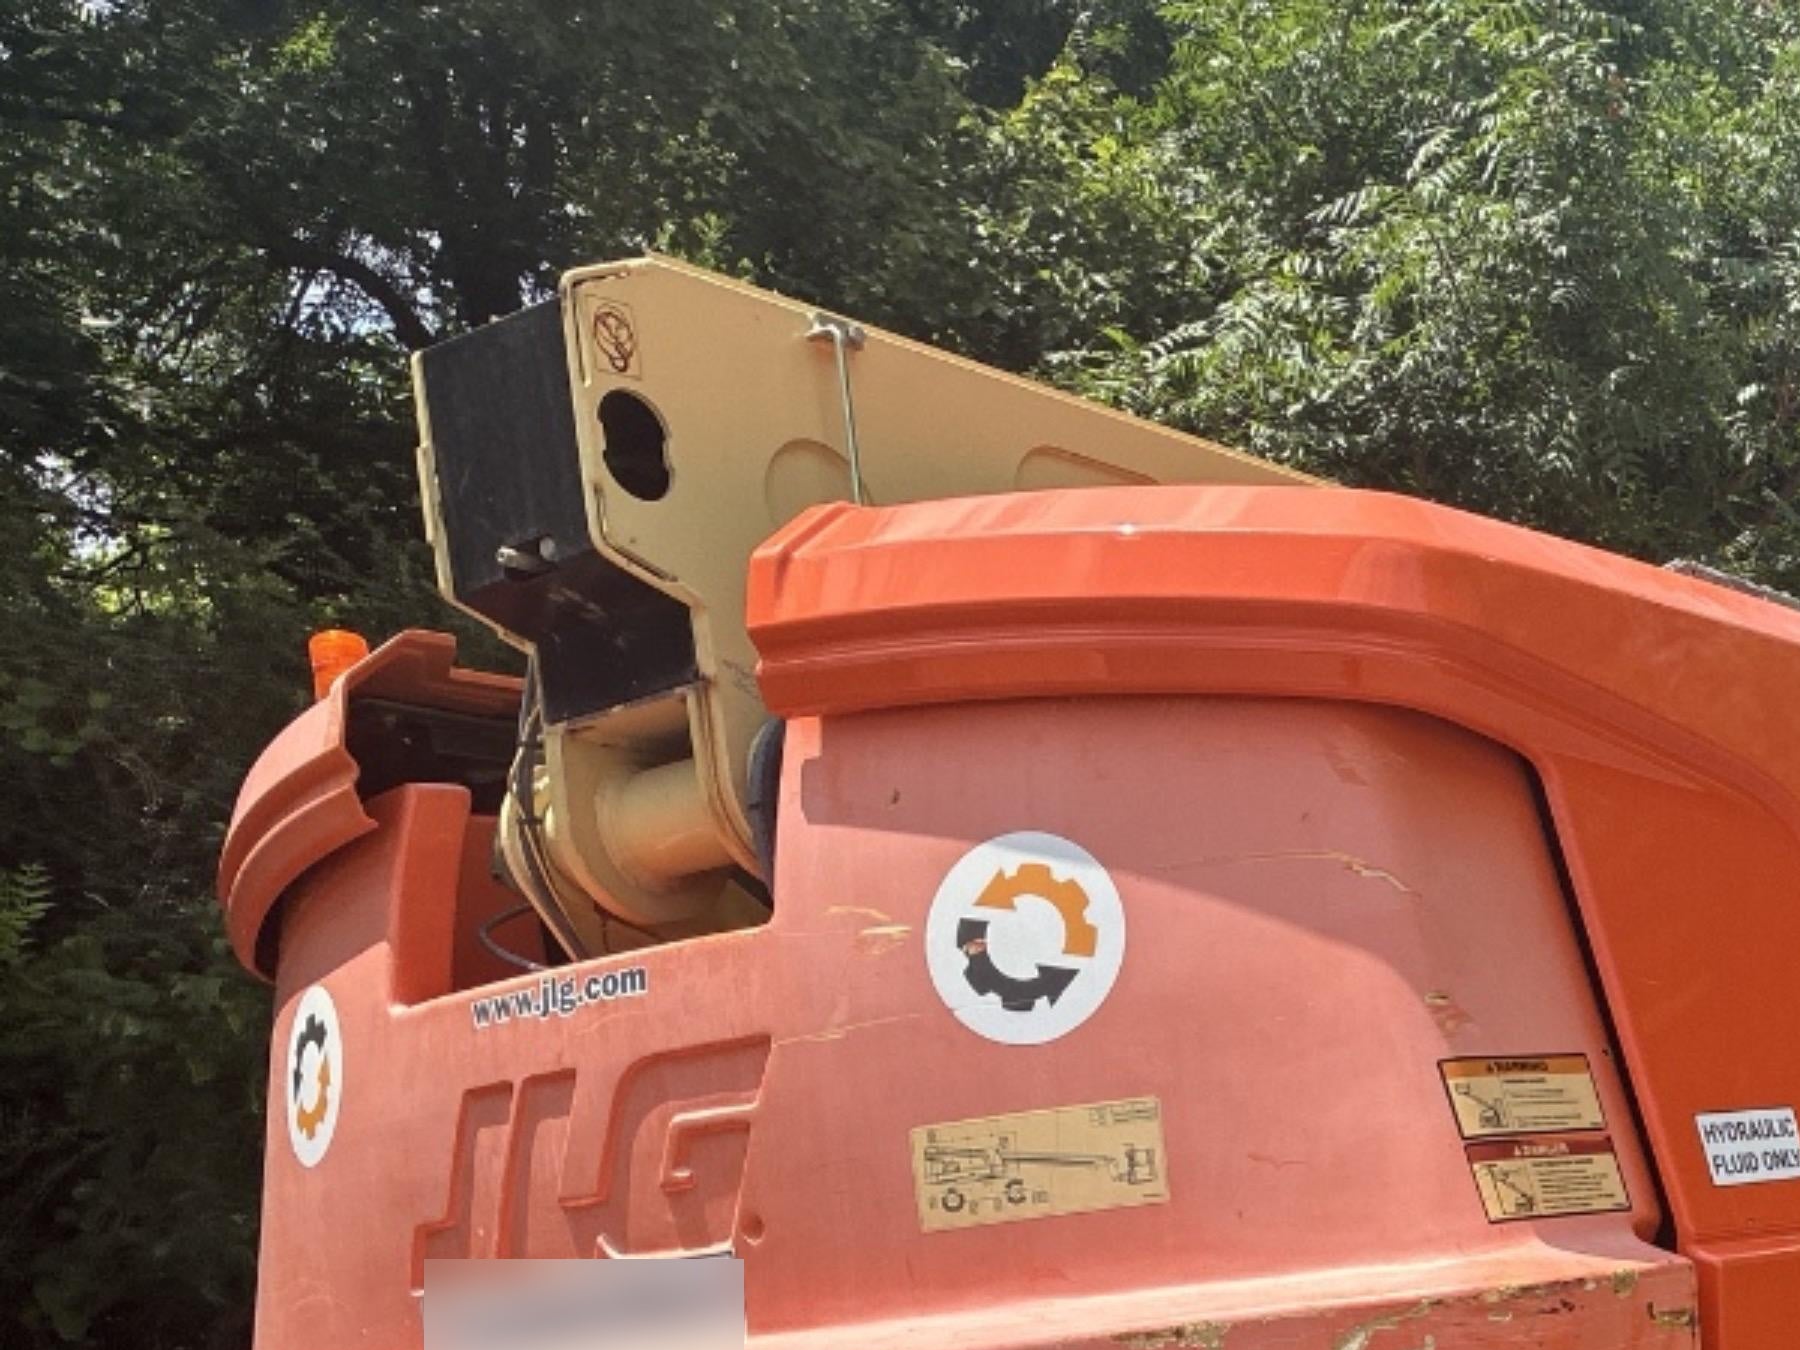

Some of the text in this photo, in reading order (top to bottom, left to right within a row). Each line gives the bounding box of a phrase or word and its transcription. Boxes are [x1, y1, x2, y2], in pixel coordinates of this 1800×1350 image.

[472, 967, 647, 1027] www.jlg.com
[1703, 1117, 1795, 1144] HYDRAULIC
[412, 1035, 773, 1296] JLG
[1712, 1148, 1800, 1175] FLUID ONLY
